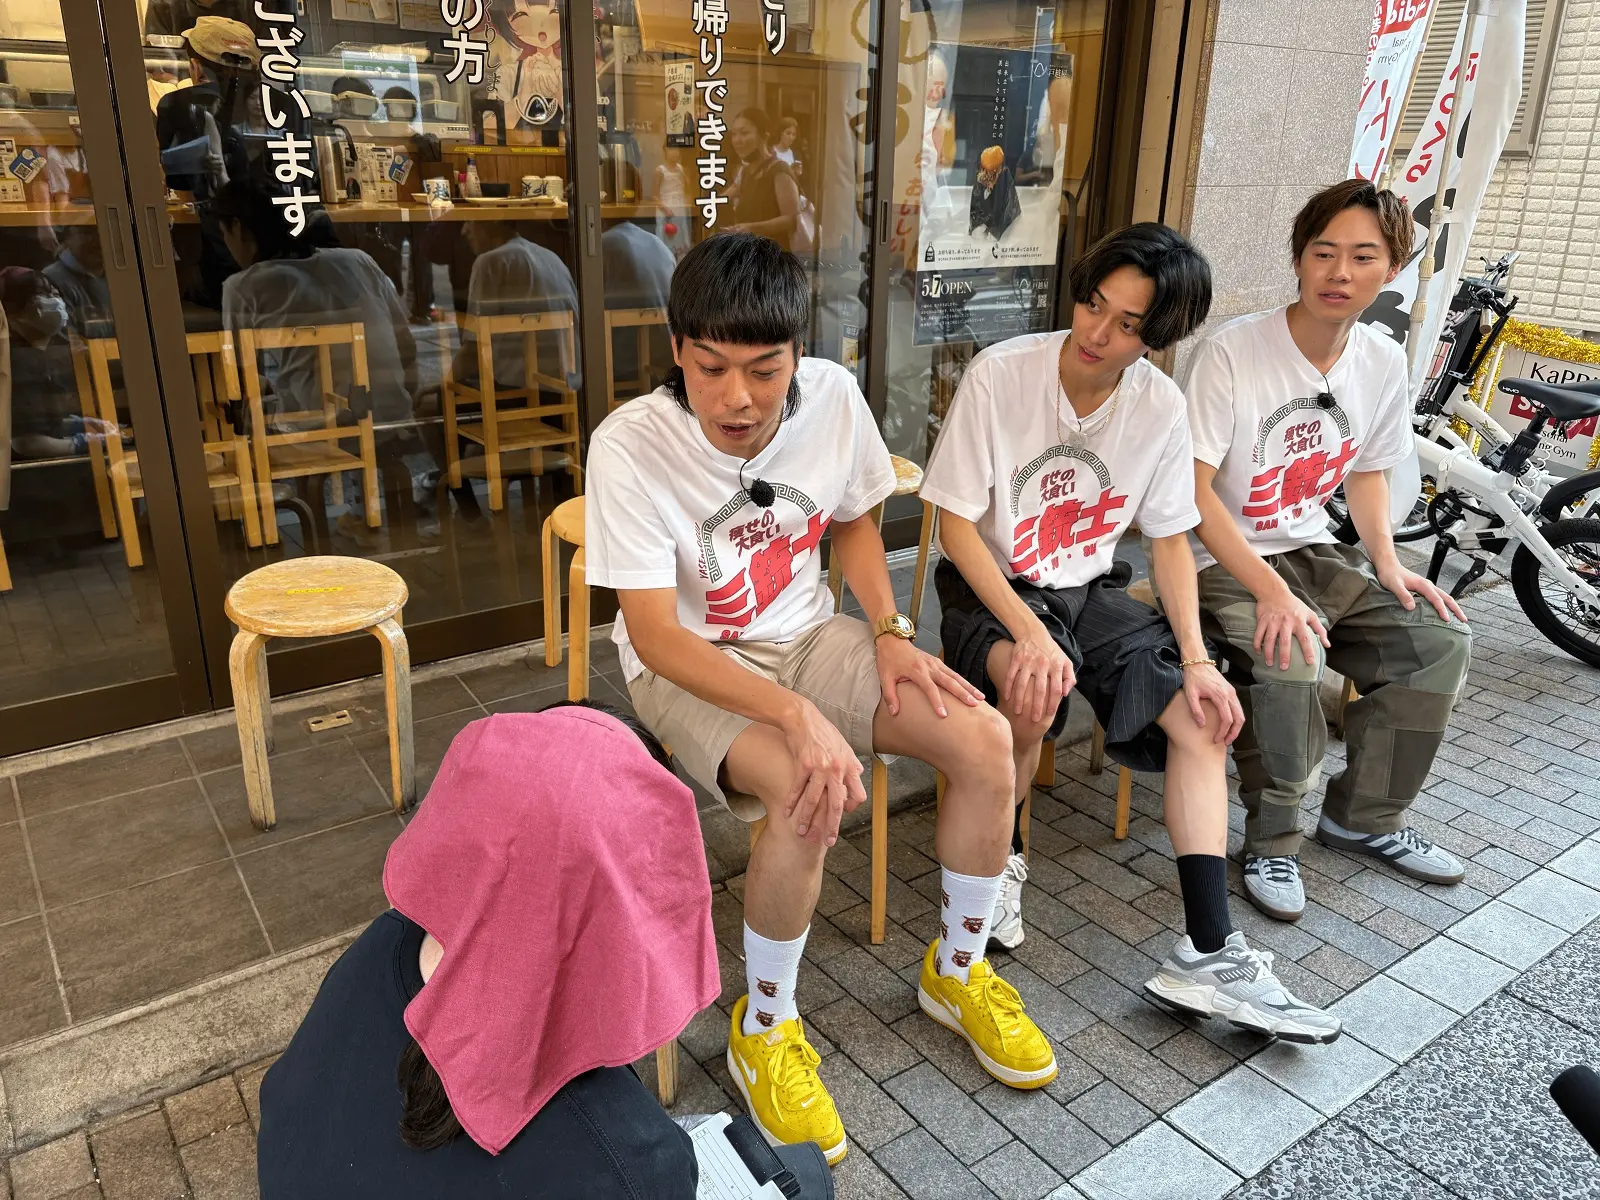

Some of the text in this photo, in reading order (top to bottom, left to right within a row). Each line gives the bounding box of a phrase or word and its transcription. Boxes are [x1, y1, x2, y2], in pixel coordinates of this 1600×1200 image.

[692, 0, 729, 229] 帰りできます
[940, 281, 973, 296] OPEN
[1283, 434, 1322, 458] 大食い
[1553, 446, 1576, 459] Gym
[1242, 437, 1362, 518] 三銃士
[1039, 481, 1076, 507] 大食い
[728, 509, 775, 542] 痩せの
[1009, 486, 1129, 574] 三銃士
[1255, 518, 1279, 532] SAN
[735, 523, 781, 558] 大食い
